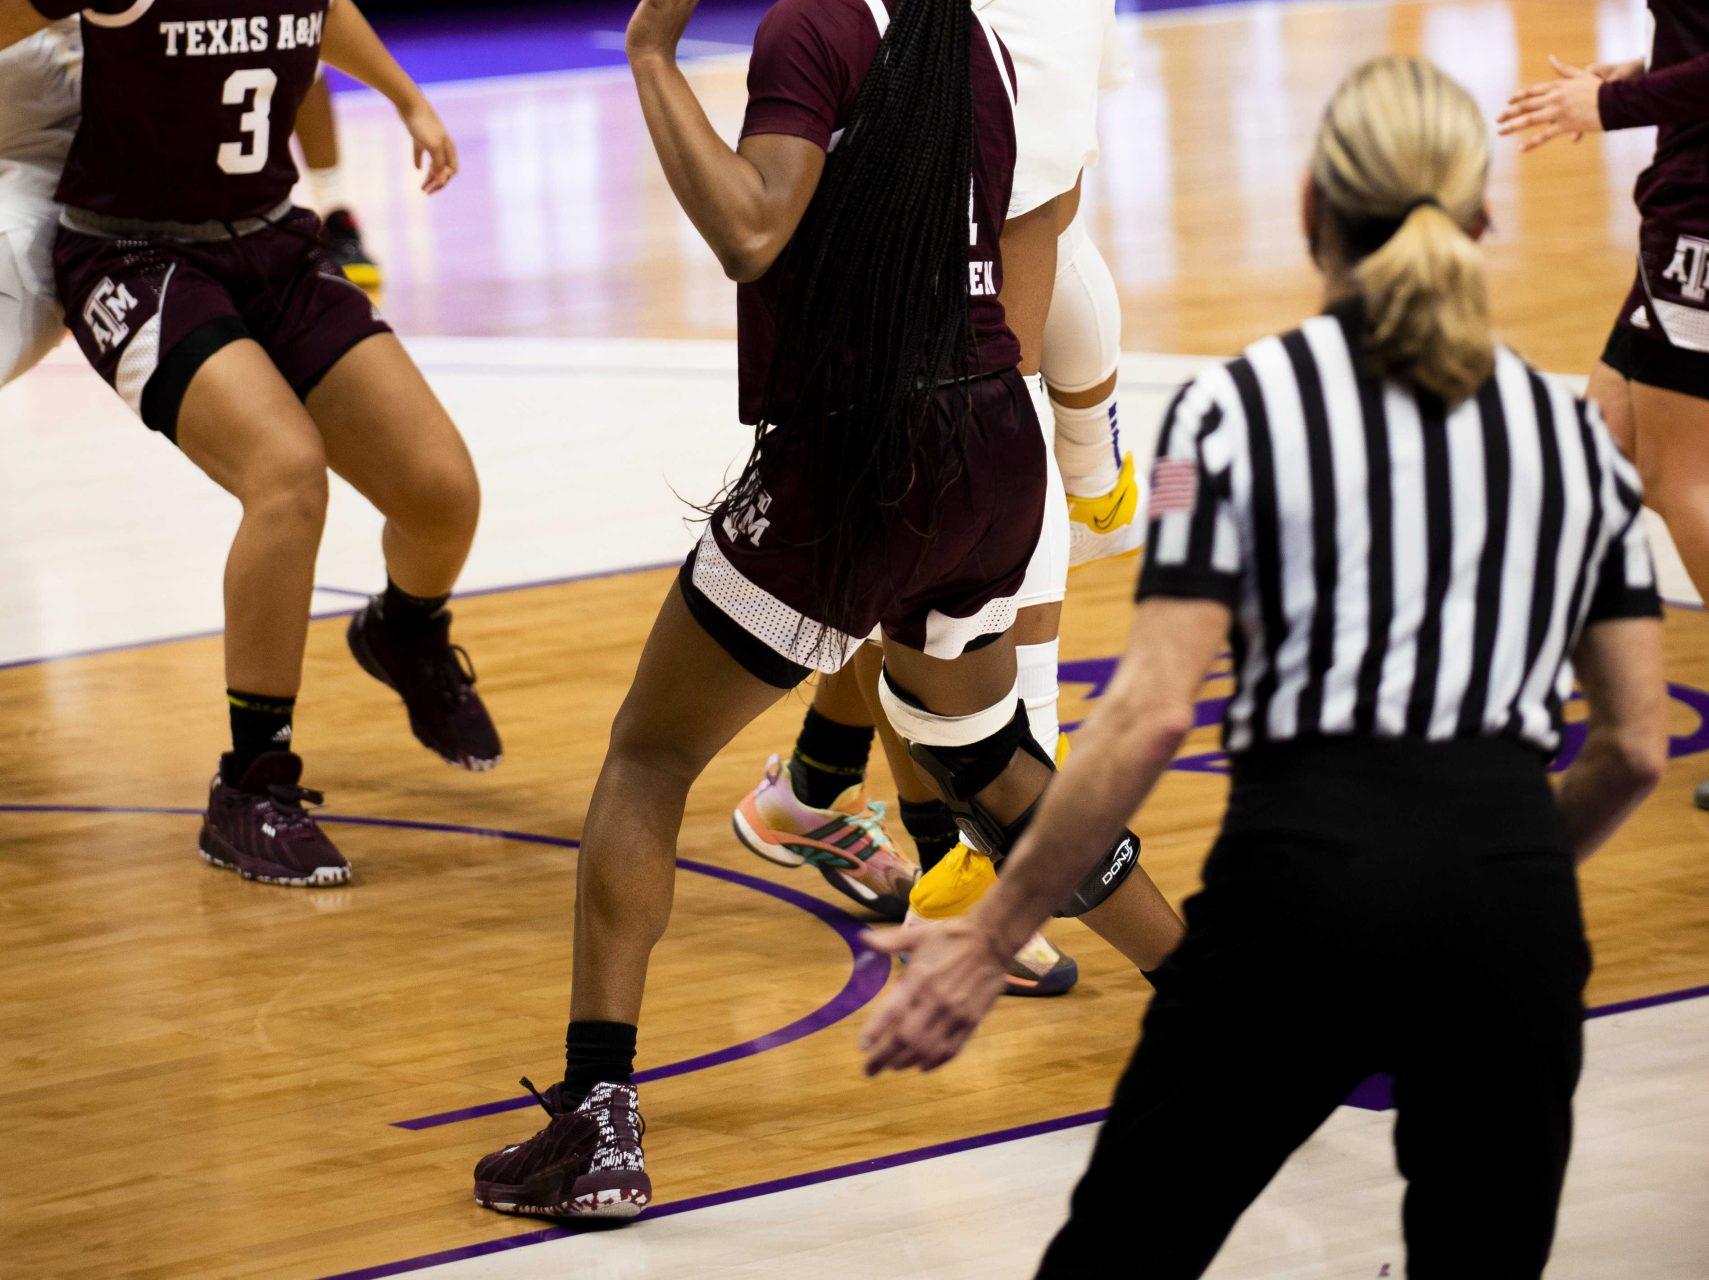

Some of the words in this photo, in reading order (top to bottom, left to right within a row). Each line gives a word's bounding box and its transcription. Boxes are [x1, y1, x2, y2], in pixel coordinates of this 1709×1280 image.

[159, 16, 268, 56] TEXAS
[276, 10, 324, 50] A&M
[216, 68, 278, 174] 3
